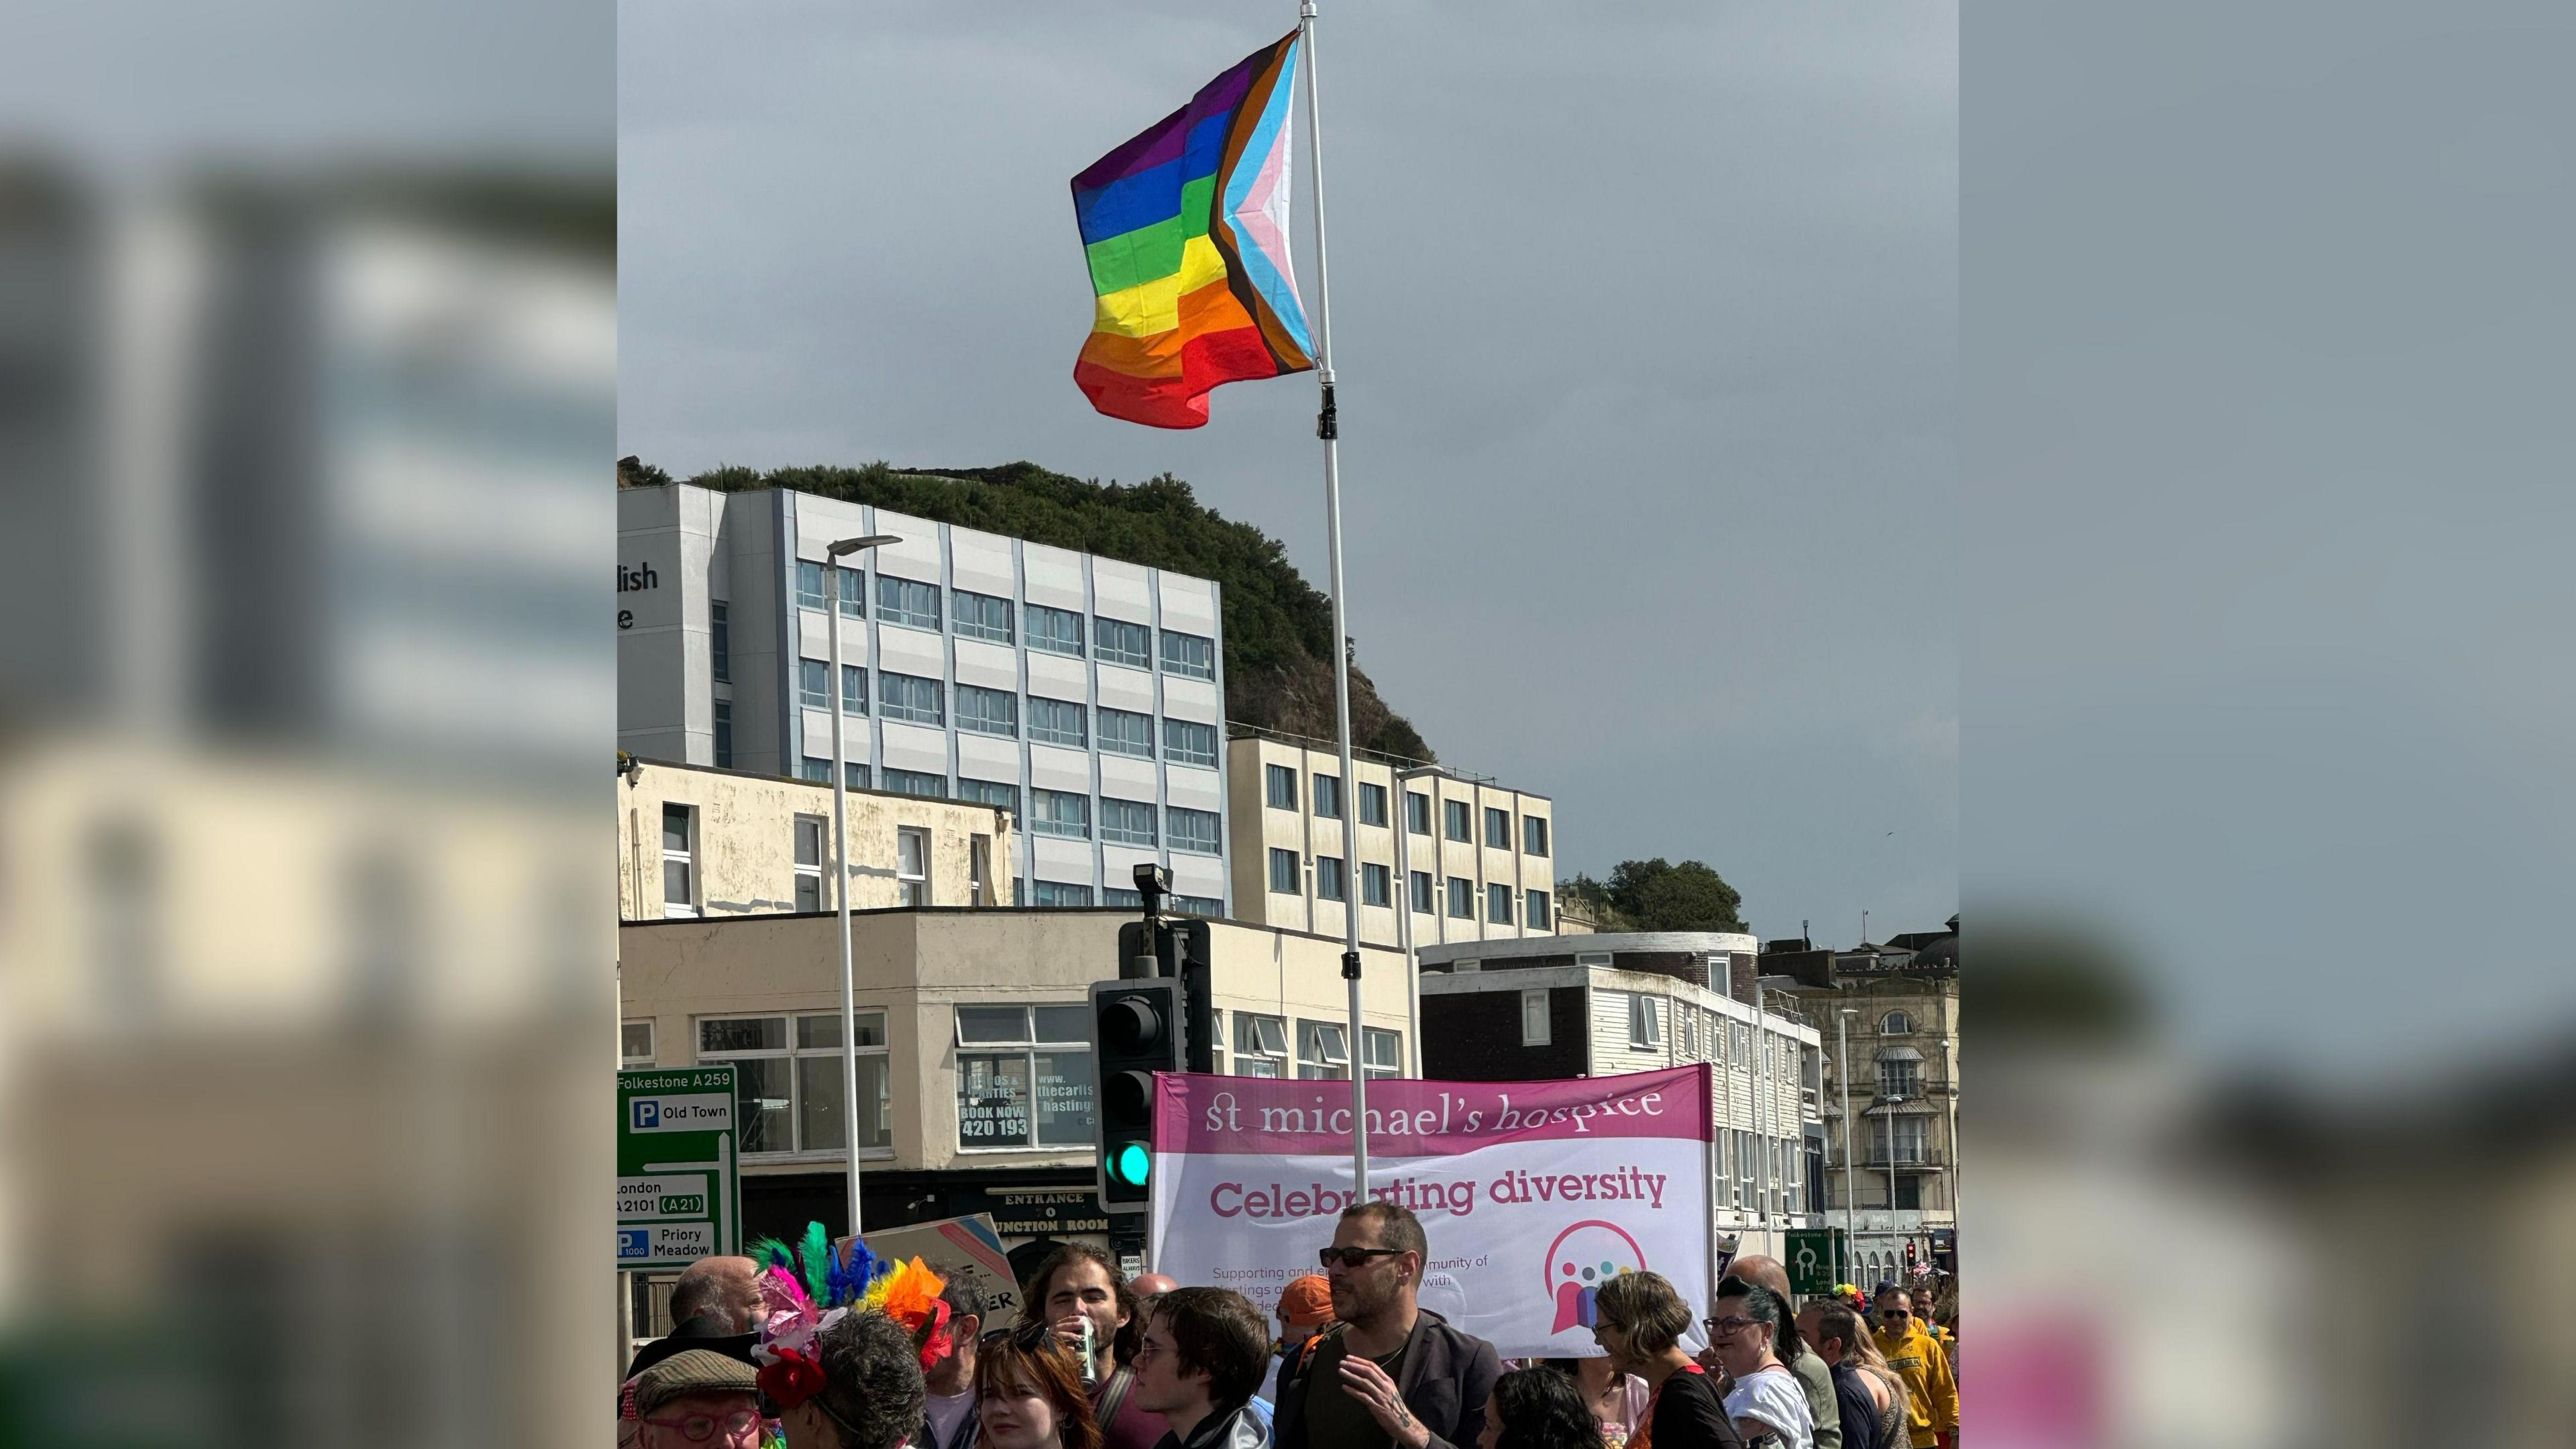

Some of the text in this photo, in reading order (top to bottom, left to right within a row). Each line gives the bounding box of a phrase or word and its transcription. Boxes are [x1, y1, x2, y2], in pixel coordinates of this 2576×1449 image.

[617, 1076, 688, 1089] Folkestone
[663, 1107, 686, 1119] Old
[692, 1106, 727, 1118] Town
[961, 1106, 1024, 1119] BOOK NOW
[1491, 1093, 1664, 1132] hospice
[963, 1119, 1028, 1136] 420 193
[617, 1182, 661, 1193] ondon
[1489, 1166, 1666, 1208] diversity
[1006, 1193, 1085, 1205] ENTRANCE
[996, 1219, 1108, 1233] UNCTION ROOM
[662, 1229, 701, 1242] Priory
[654, 1244, 710, 1256] Meadow
[1213, 1267, 1284, 1281] Supporting
[1288, 1265, 1313, 1277] and
[1426, 1256, 1472, 1270] munity
[1476, 1254, 1487, 1267] of
[1214, 1284, 1270, 1297] tings
[1423, 1275, 1451, 1287] with
